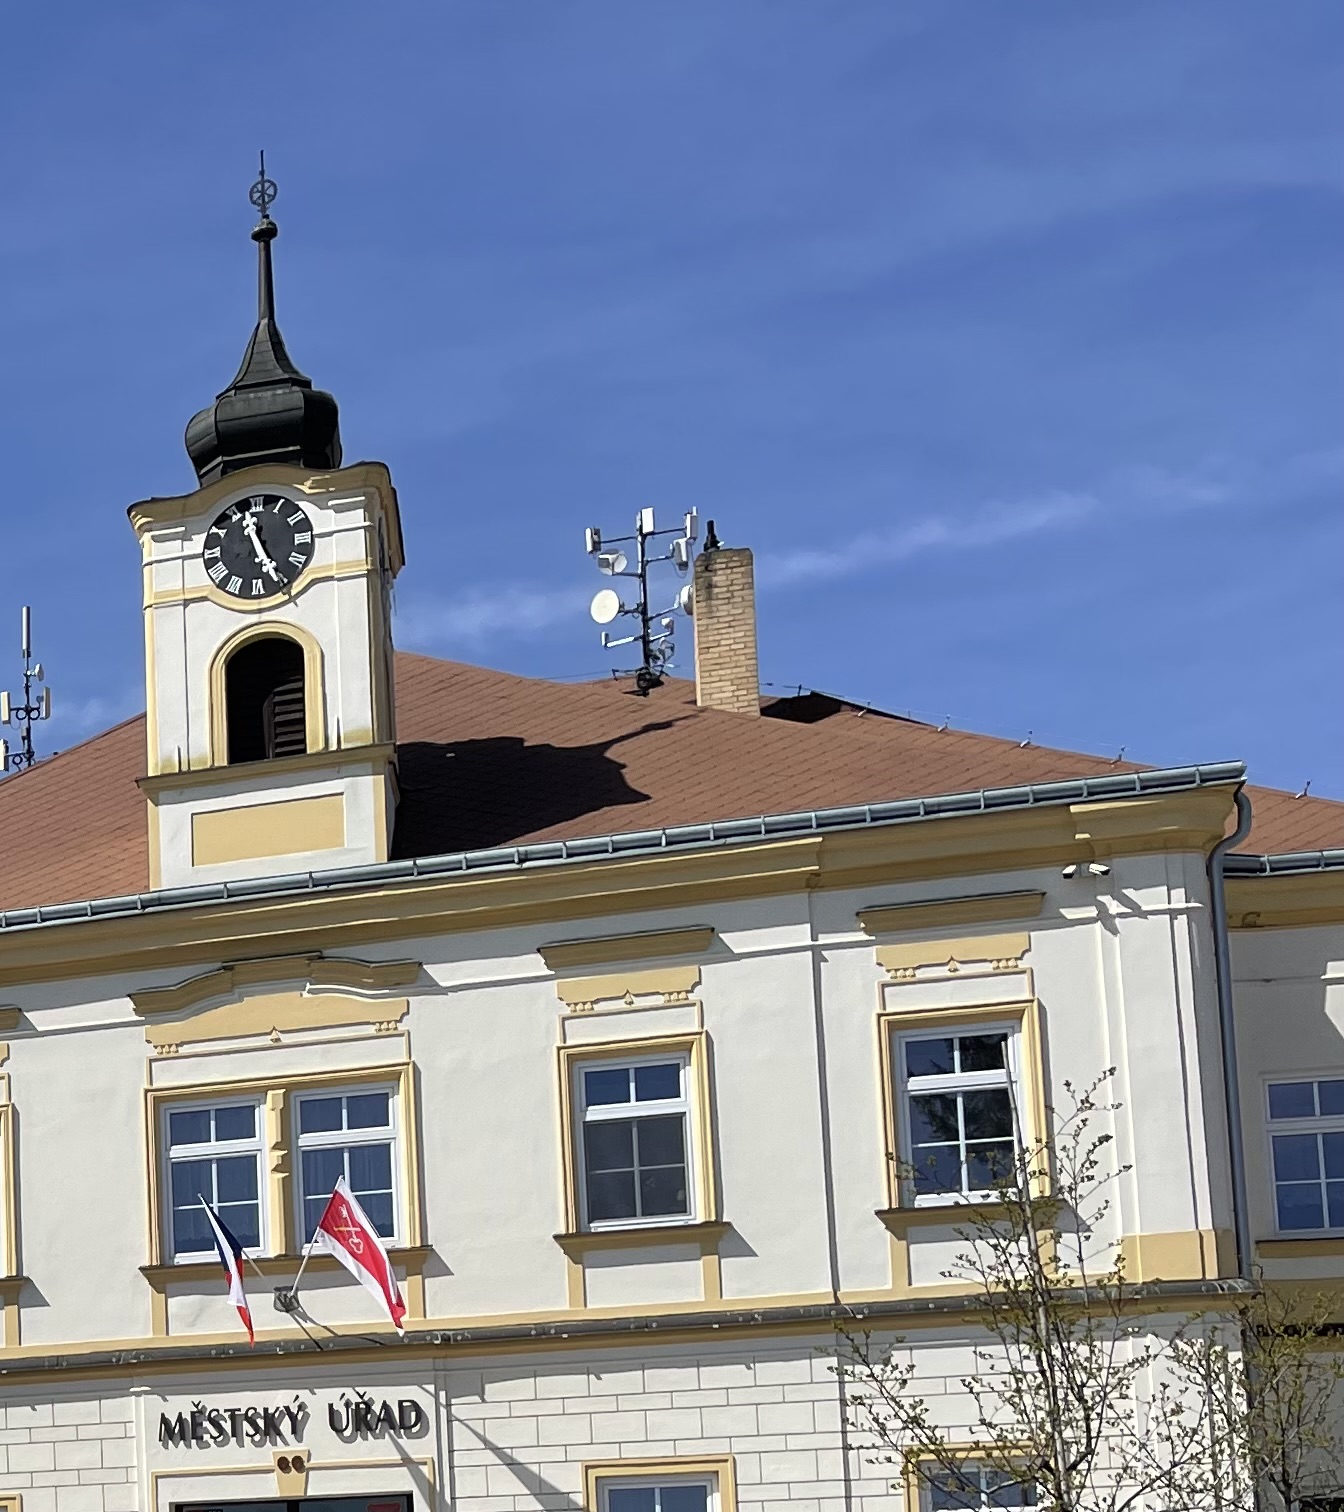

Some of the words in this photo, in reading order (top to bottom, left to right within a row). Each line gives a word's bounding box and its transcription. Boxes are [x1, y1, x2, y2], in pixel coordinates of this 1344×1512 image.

[273, 499, 285, 513] I
[287, 511, 306, 526] II
[209, 526, 227, 538] X
[294, 531, 311, 545] III
[252, 579, 265, 595] VI
[159, 1394, 301, 1442] MĚSTSKÝ
[328, 1390, 422, 1433] ÚŘAD
